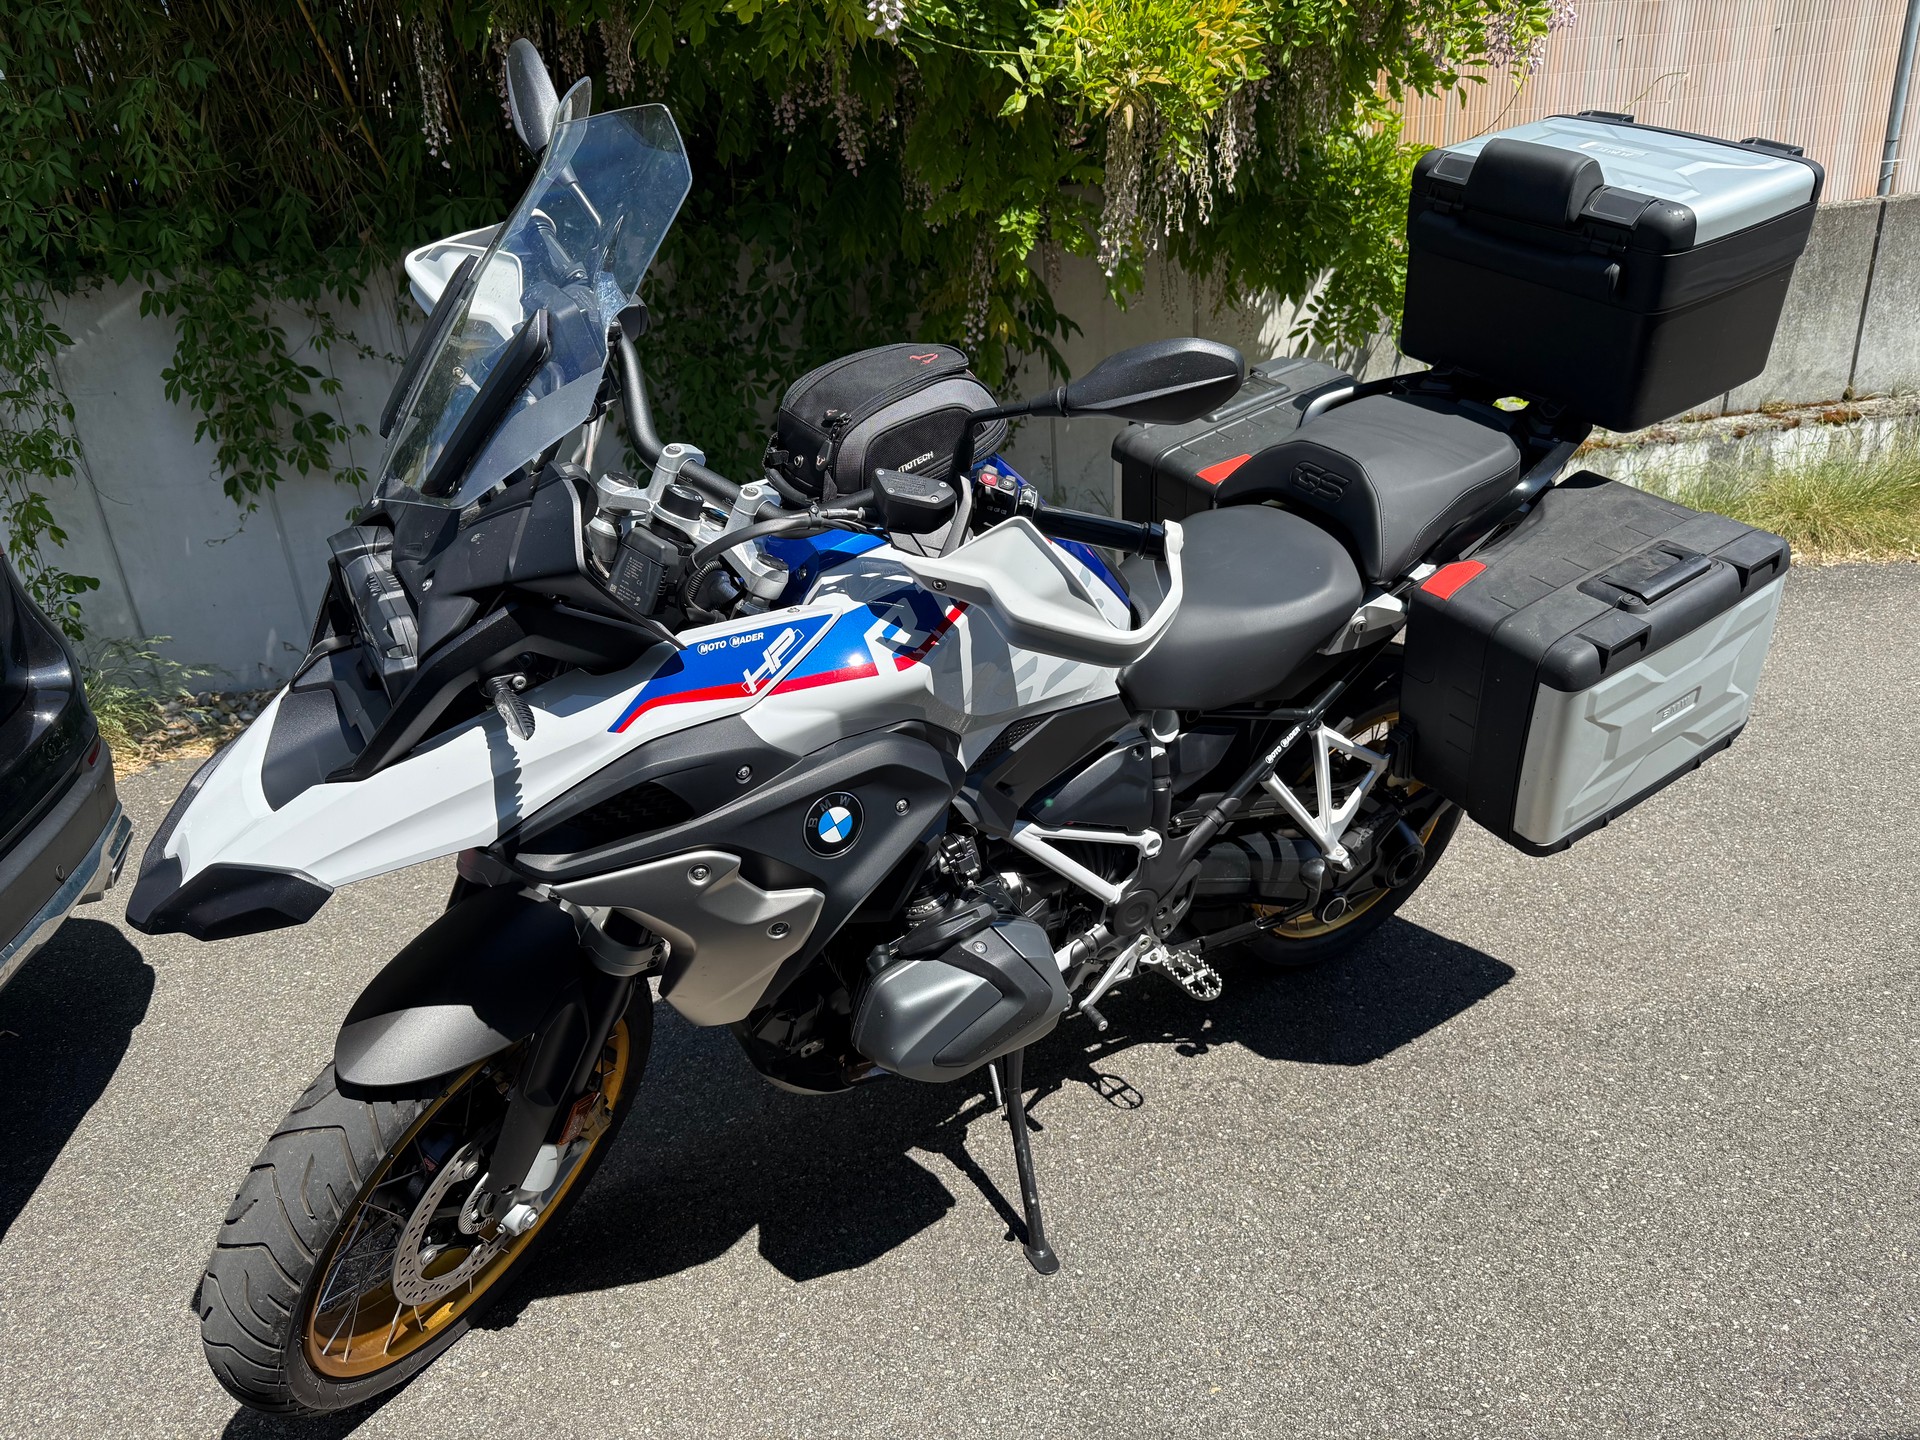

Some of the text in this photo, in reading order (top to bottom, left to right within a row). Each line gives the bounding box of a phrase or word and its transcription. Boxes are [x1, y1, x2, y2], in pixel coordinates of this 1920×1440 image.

[1290, 461, 1352, 502] GS
[697, 632, 764, 655] MOTO MADER
[742, 627, 804, 695] HP
[1265, 726, 1300, 764] MOTO MADER
[808, 795, 850, 828] BMW
